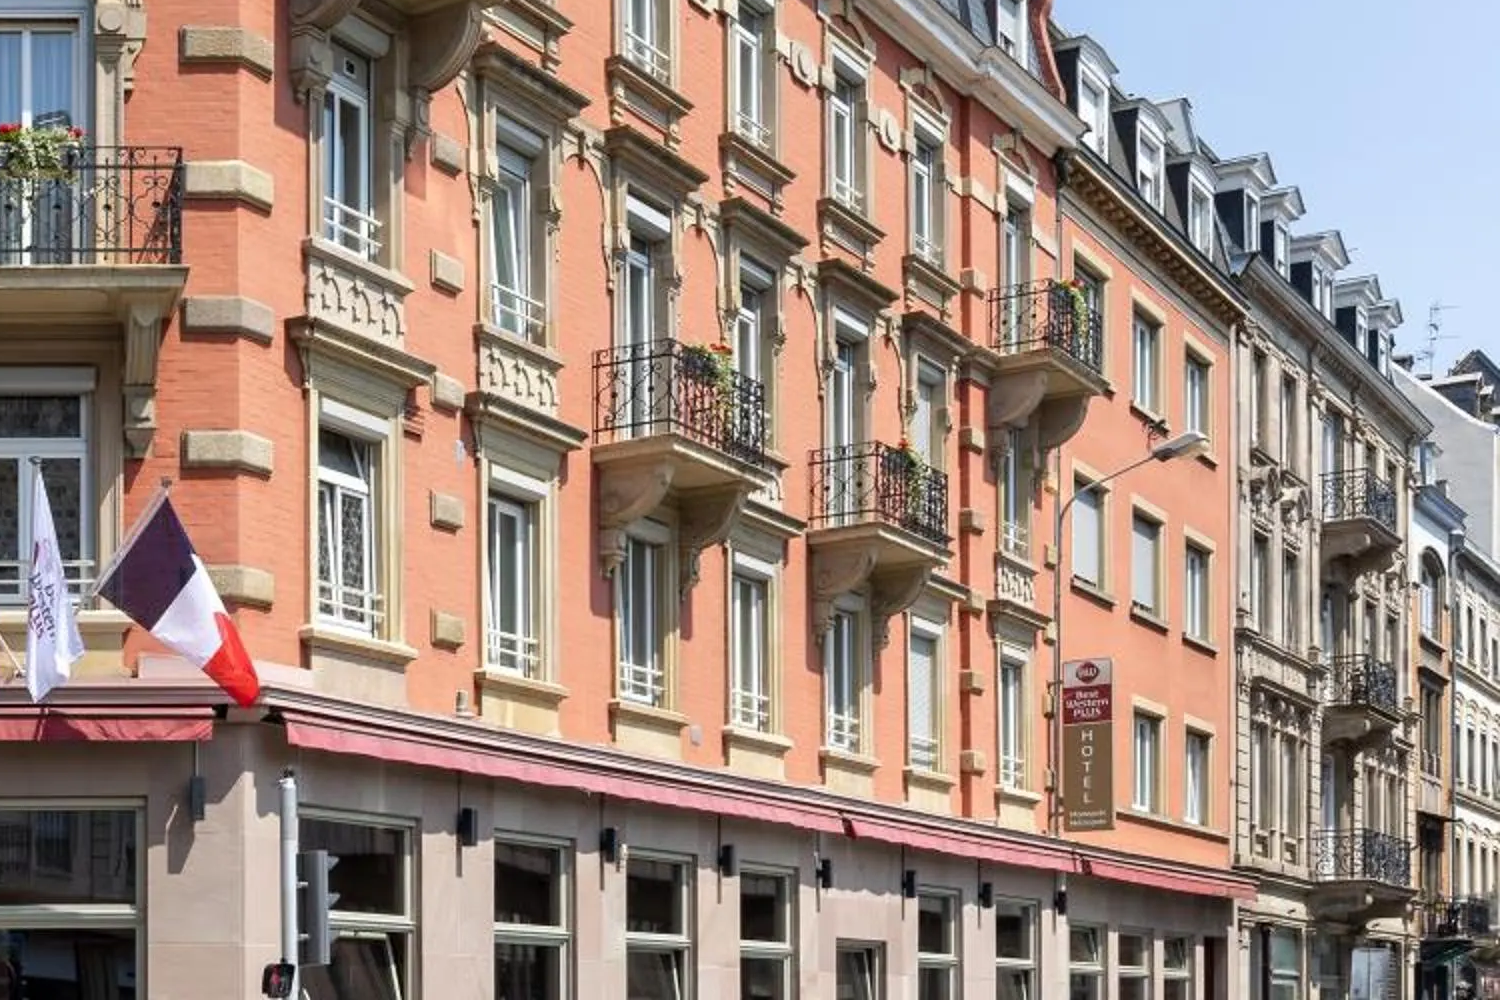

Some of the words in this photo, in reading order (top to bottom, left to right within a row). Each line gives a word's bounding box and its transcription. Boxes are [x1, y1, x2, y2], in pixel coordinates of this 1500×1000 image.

[1075, 690, 1099, 700] Best
[1066, 699, 1109, 709] Western
[1081, 729, 1094, 805] HOTEL
